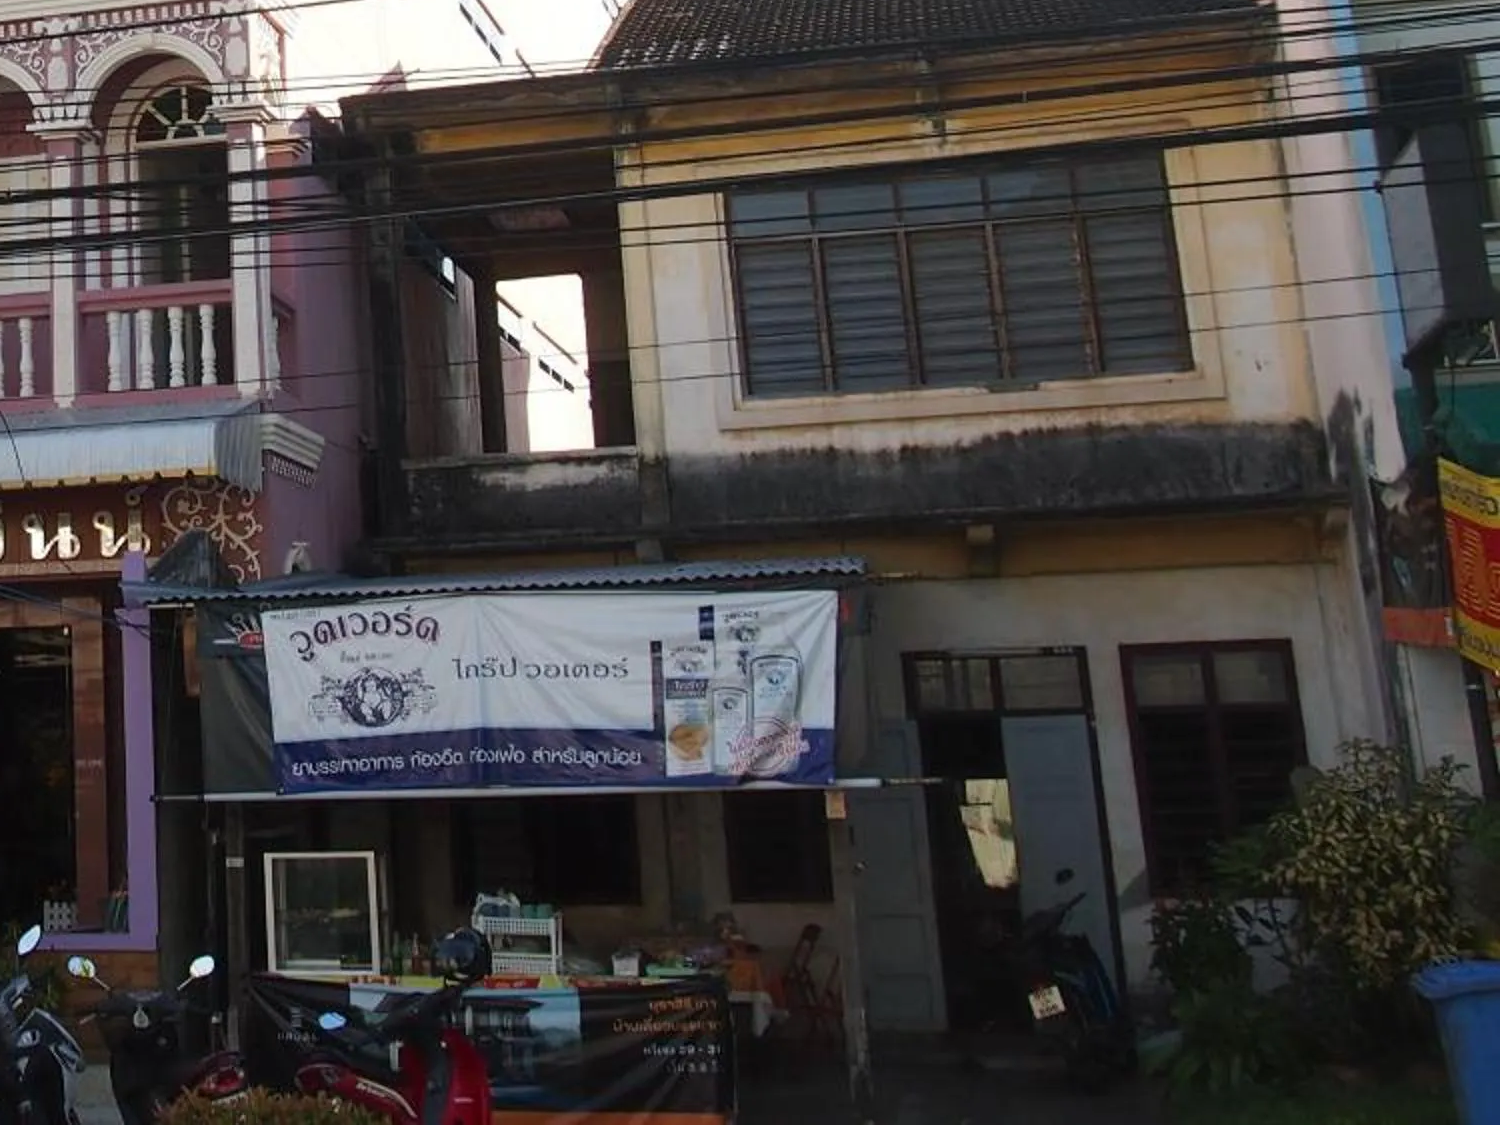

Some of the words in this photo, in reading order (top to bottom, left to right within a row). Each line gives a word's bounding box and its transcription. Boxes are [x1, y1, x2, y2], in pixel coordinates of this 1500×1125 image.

[289, 605, 441, 662] วูดเวอร์ด
[523, 656, 629, 680] วอเตอร์
[532, 746, 642, 768] สำหรับลูกน้อย
